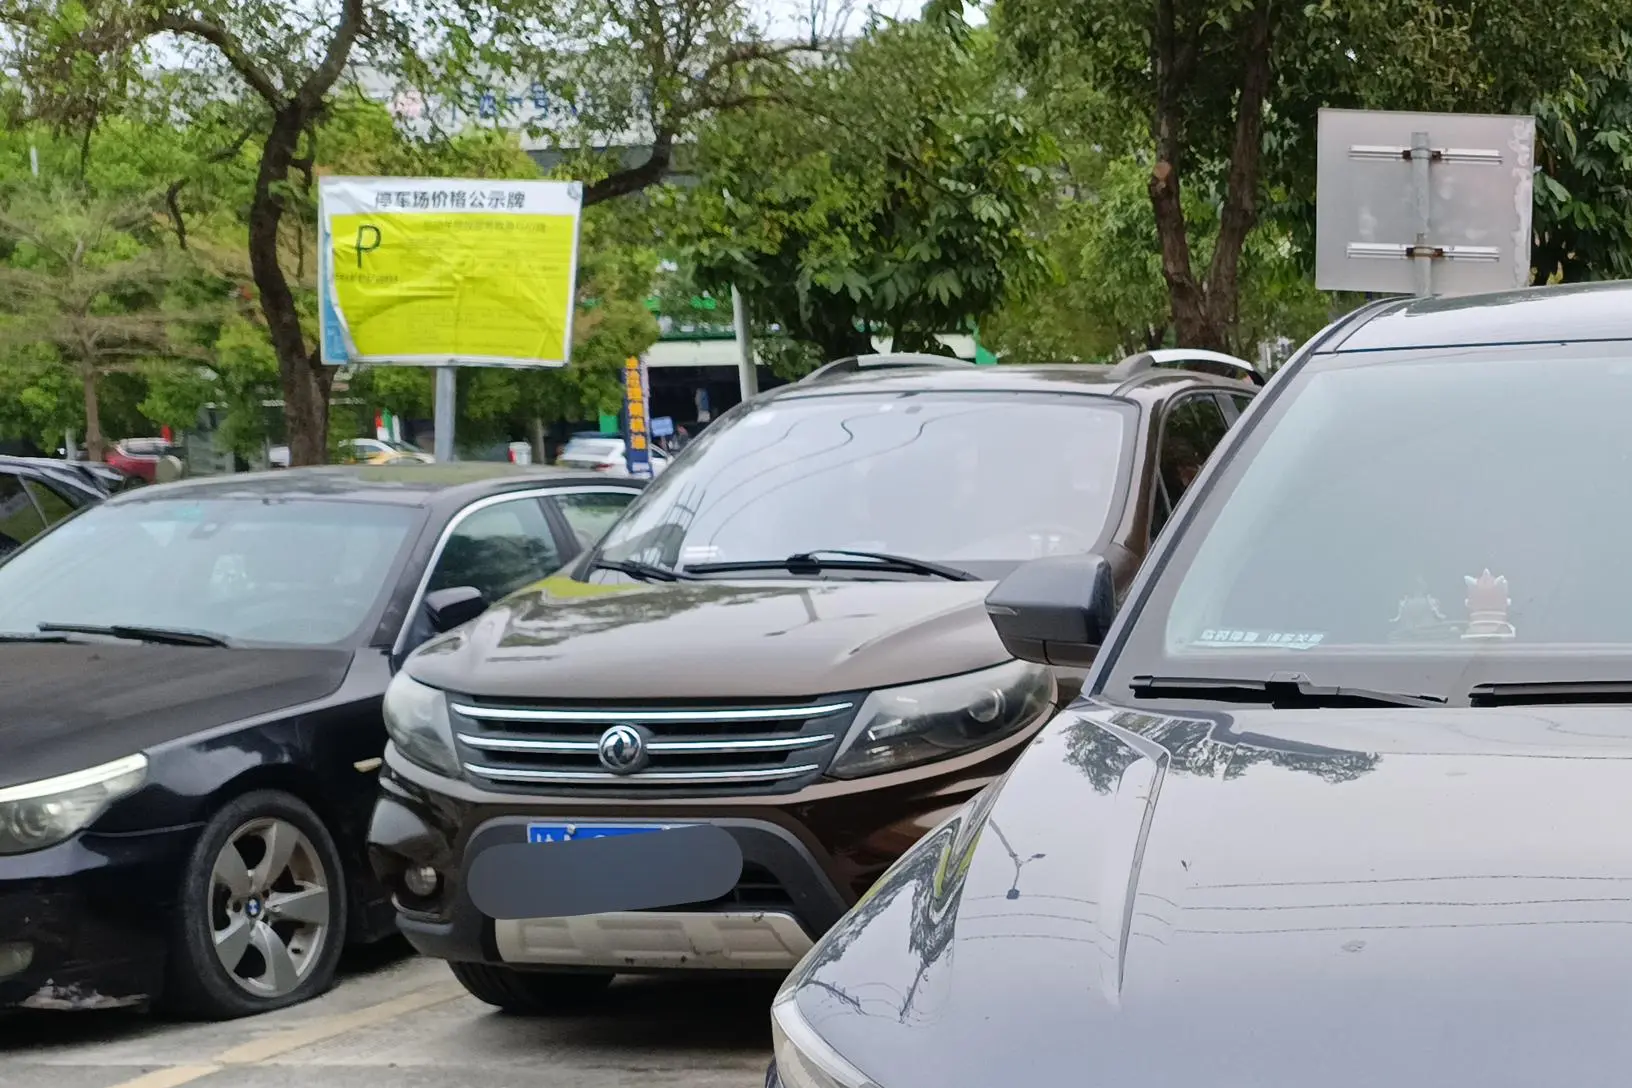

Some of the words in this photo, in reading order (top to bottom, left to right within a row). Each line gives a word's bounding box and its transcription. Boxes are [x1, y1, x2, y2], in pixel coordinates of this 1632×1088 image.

[375, 190, 525, 209] 停车场价格公示牌
[355, 224, 381, 269] P
